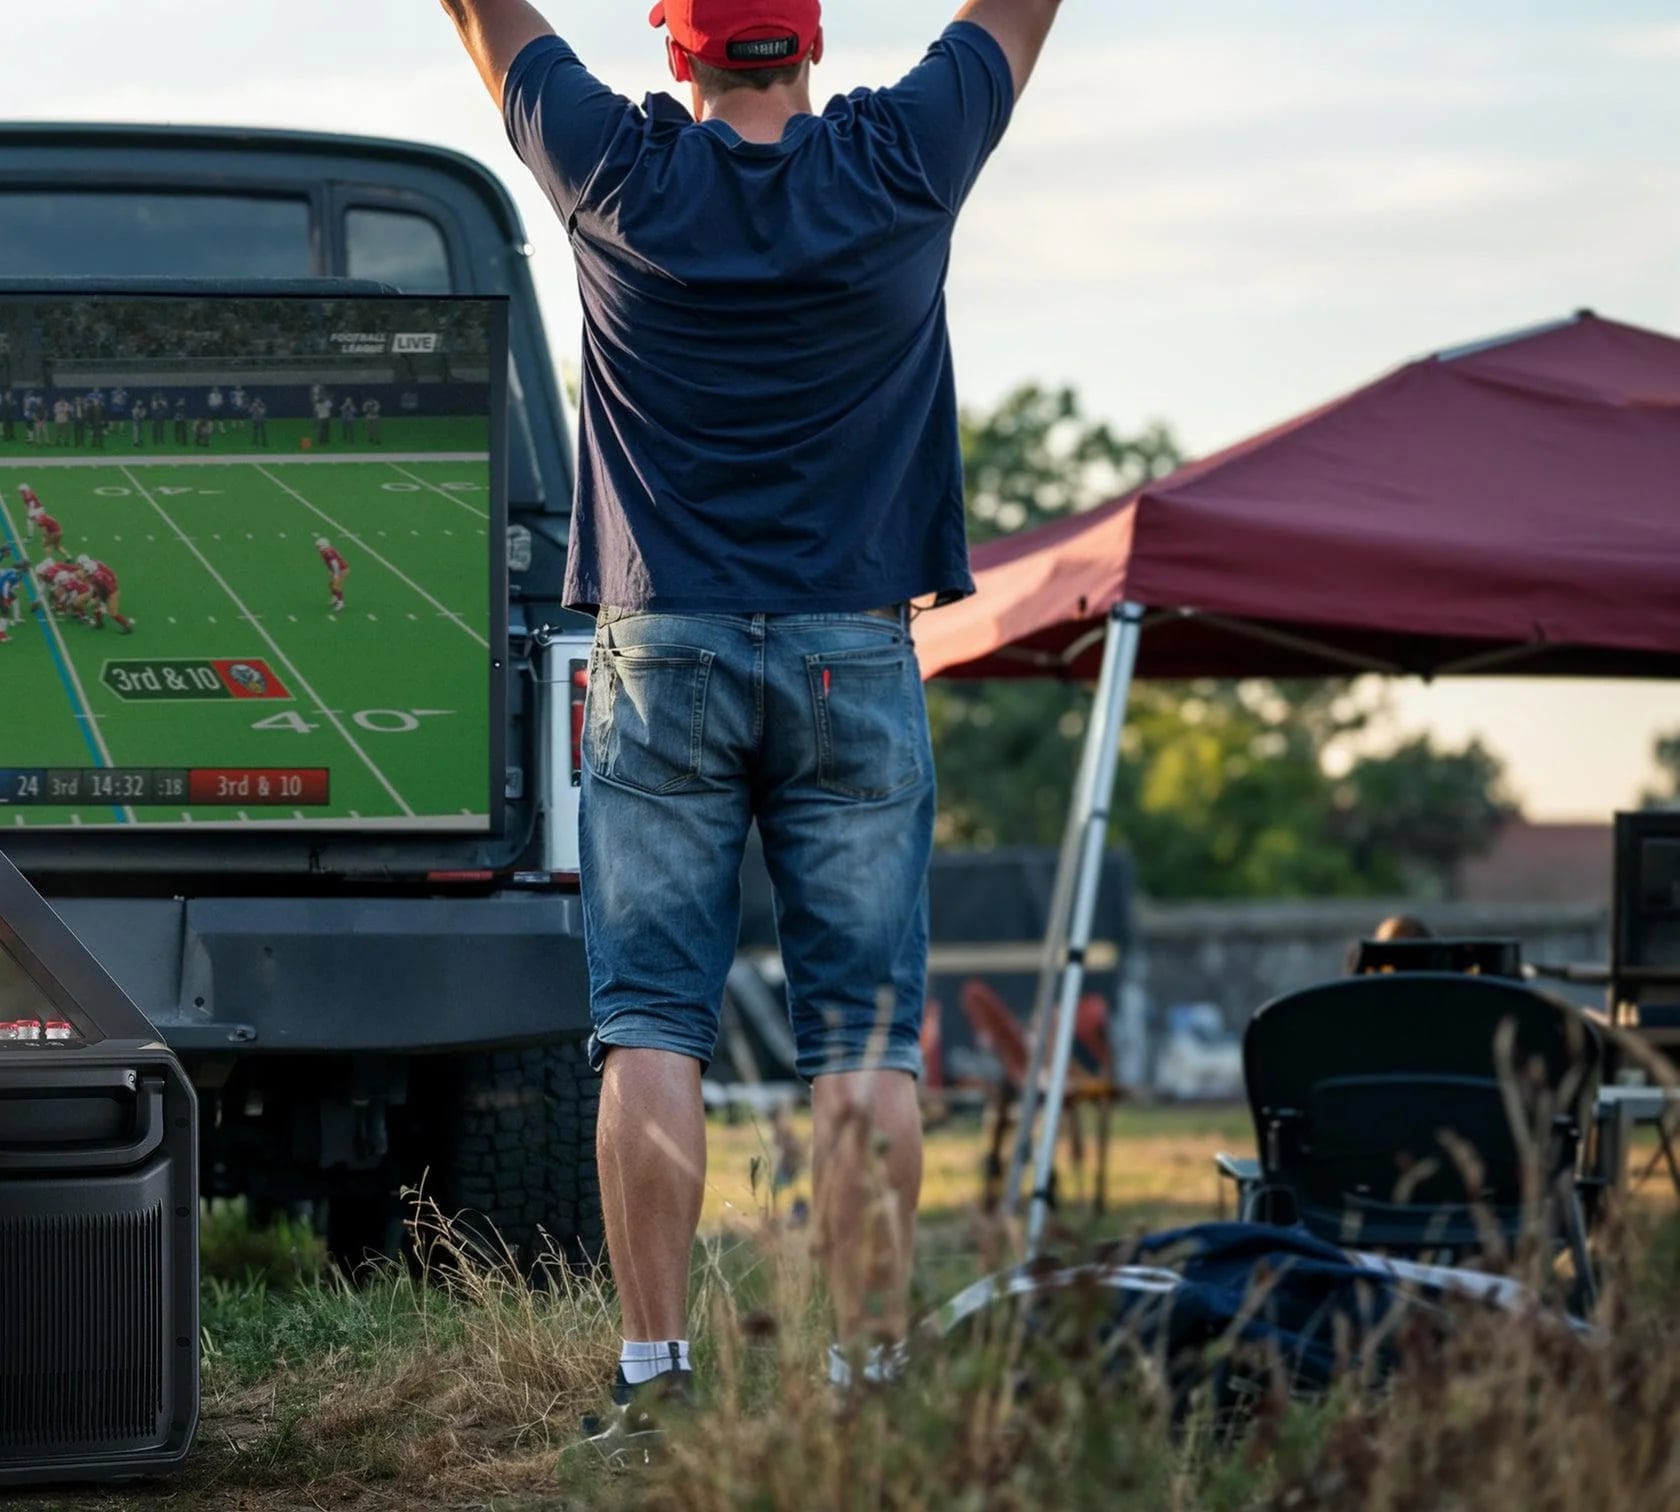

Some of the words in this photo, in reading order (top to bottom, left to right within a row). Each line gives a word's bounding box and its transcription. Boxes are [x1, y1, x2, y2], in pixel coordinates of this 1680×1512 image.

[397, 337, 432, 349] LIVE
[112, 667, 161, 691] 3rd
[162, 667, 189, 690] &
[185, 667, 220, 690] 10
[17, 775, 38, 796] 24
[51, 778, 78, 795] 3rd
[91, 775, 144, 796] 14:32
[158, 778, 182, 795] :18
[216, 775, 249, 796] 3rd
[258, 776, 270, 796] &
[280, 776, 302, 796] 10
